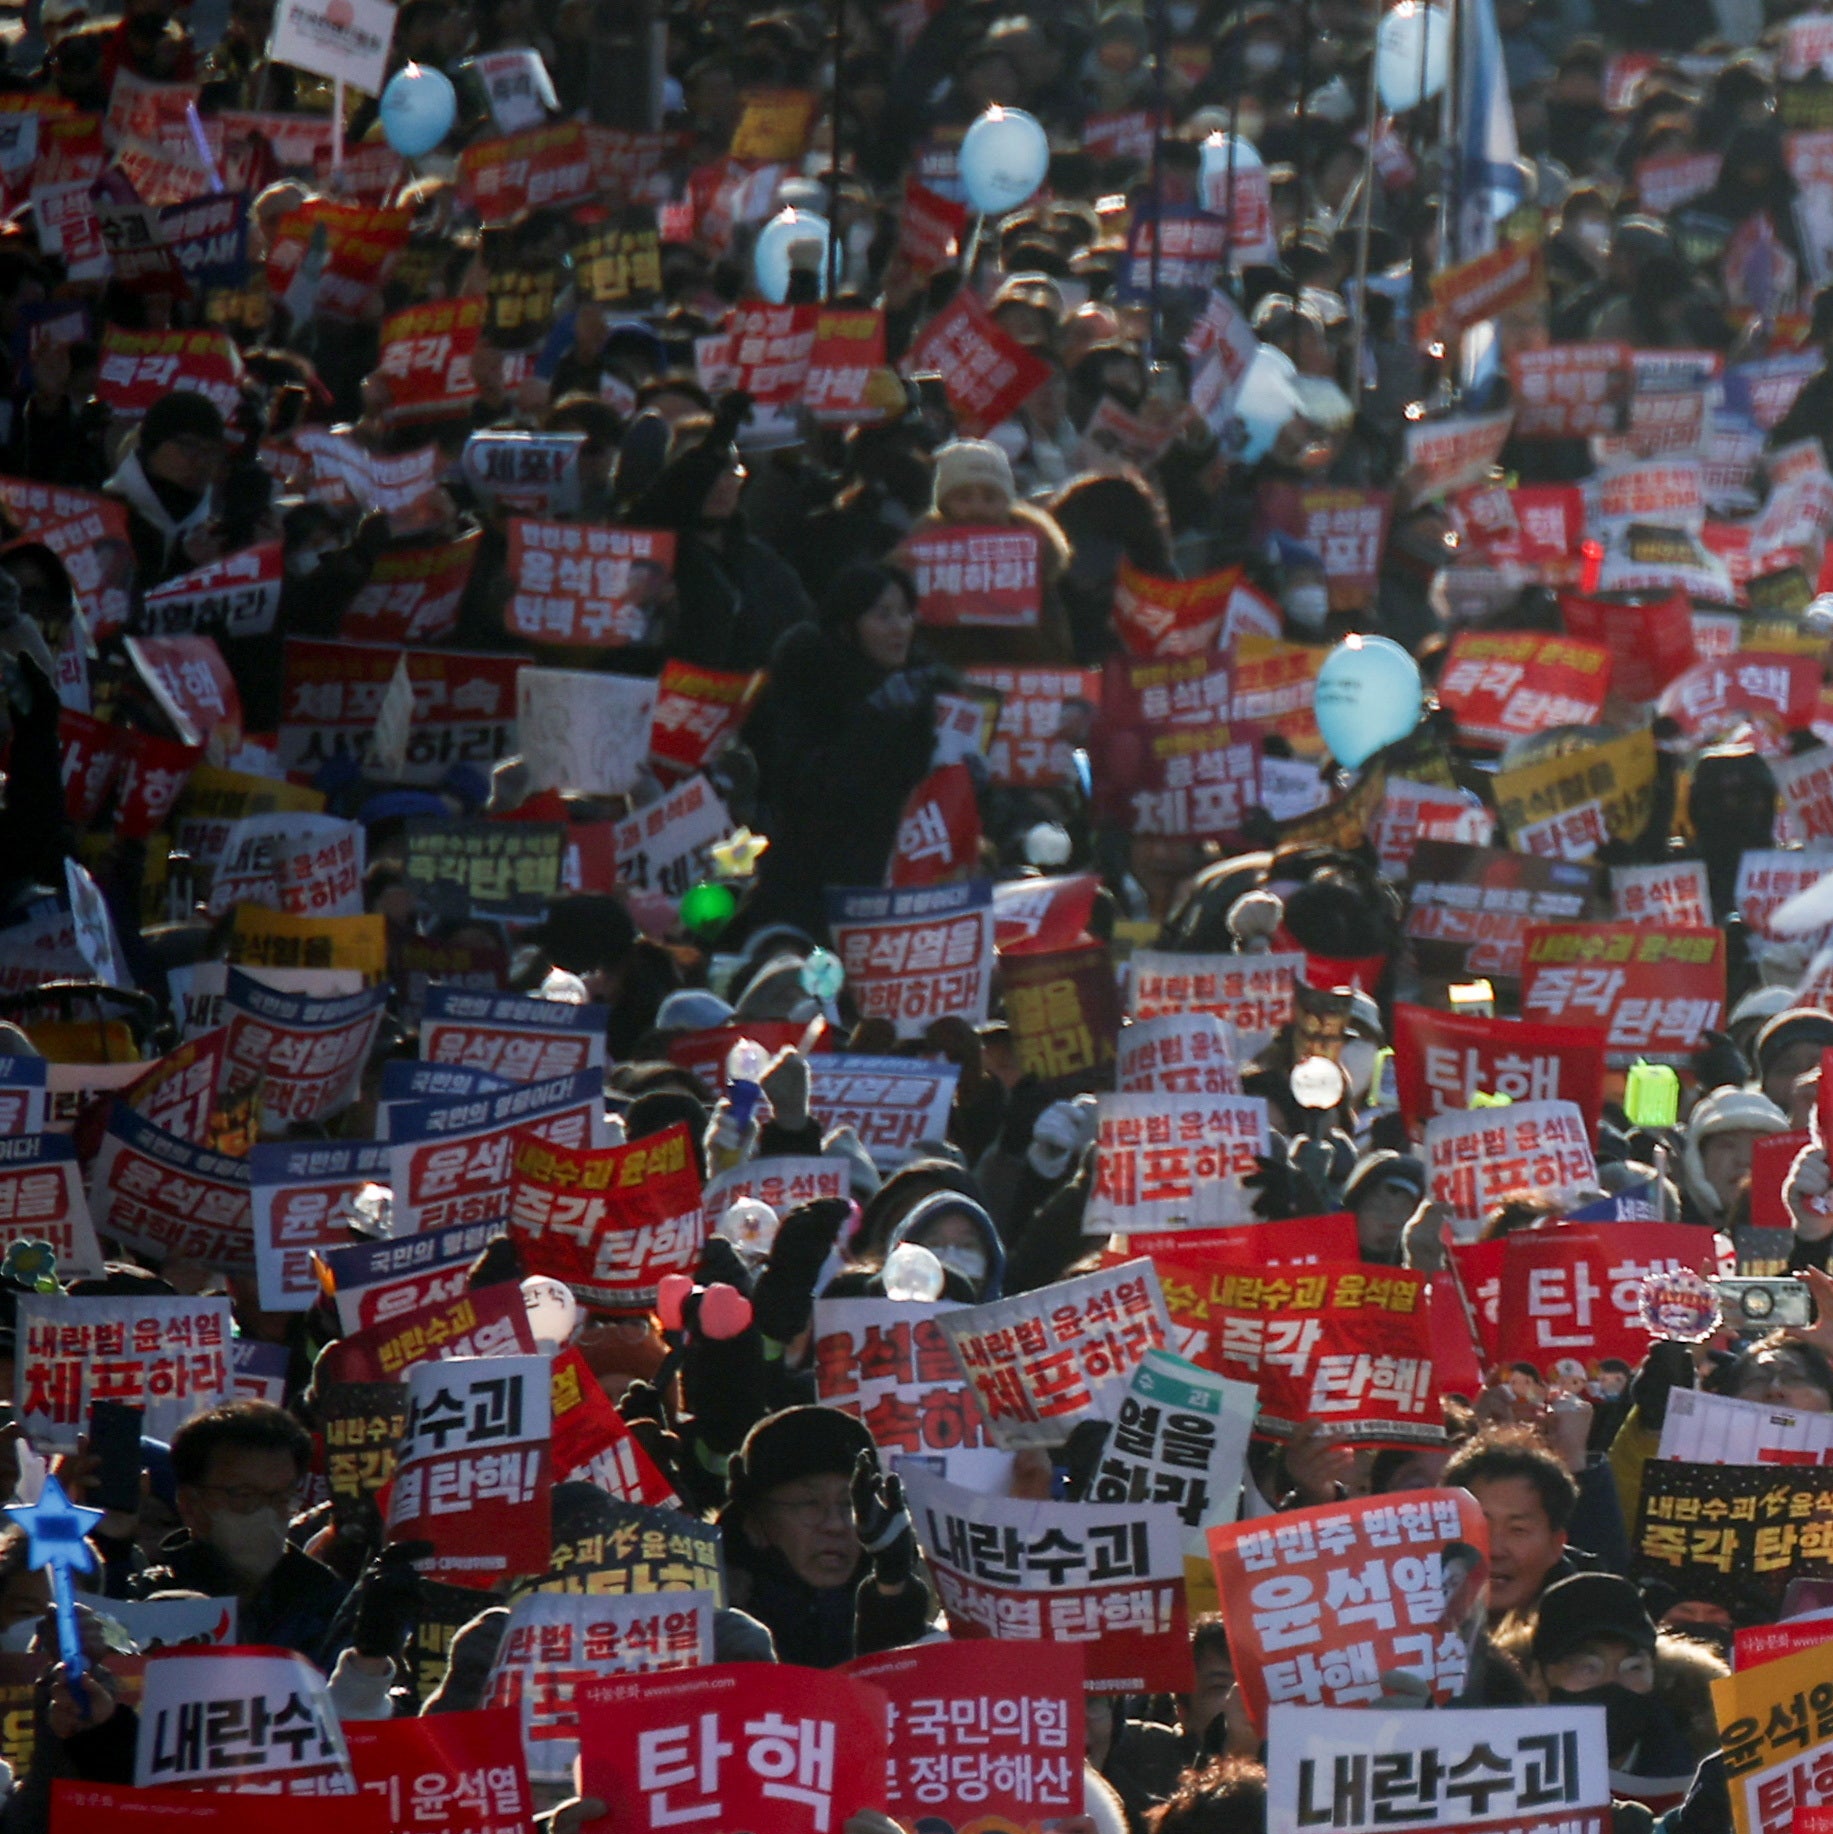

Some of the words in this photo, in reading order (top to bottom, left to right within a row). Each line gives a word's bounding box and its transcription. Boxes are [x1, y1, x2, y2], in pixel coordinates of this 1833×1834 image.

[1524, 969, 1625, 1013] 즉각
[1607, 998, 1721, 1046] 탄핵!
[426, 1103, 489, 1130] 국민의
[512, 1183, 606, 1248] 즉각
[594, 1208, 705, 1283] 탄핵!
[1208, 1273, 1326, 1314] 내란수괴
[1332, 1273, 1420, 1313] 윤석열
[26, 1323, 125, 1360] 내란범
[131, 1312, 223, 1353] 윤석열
[960, 1315, 1048, 1370] 내란범
[1048, 1274, 1152, 1342] 윤석열
[1220, 1315, 1322, 1370] 즉각
[21, 1349, 228, 1427] 체포하라
[1307, 1353, 1433, 1416] 탄핵!
[1363, 1500, 1462, 1543] 반헌법
[1647, 1492, 1758, 1523] 내란수괴
[928, 1520, 1151, 1588] 내란수괴
[1641, 1522, 1740, 1572] 즉각
[583, 1606, 700, 1655] 윤석열
[1047, 1586, 1176, 1644] 탄핵!
[1249, 1552, 1447, 1654] 윤석열
[1262, 1642, 1381, 1708] 탄핵
[906, 1695, 1071, 1750] 국민의힘
[409, 1764, 523, 1822] 윤석열
[637, 1710, 837, 1834] 탄핵
[909, 1753, 1074, 1806] 정당해산
[1295, 1731, 1581, 1828] 내란수괴
